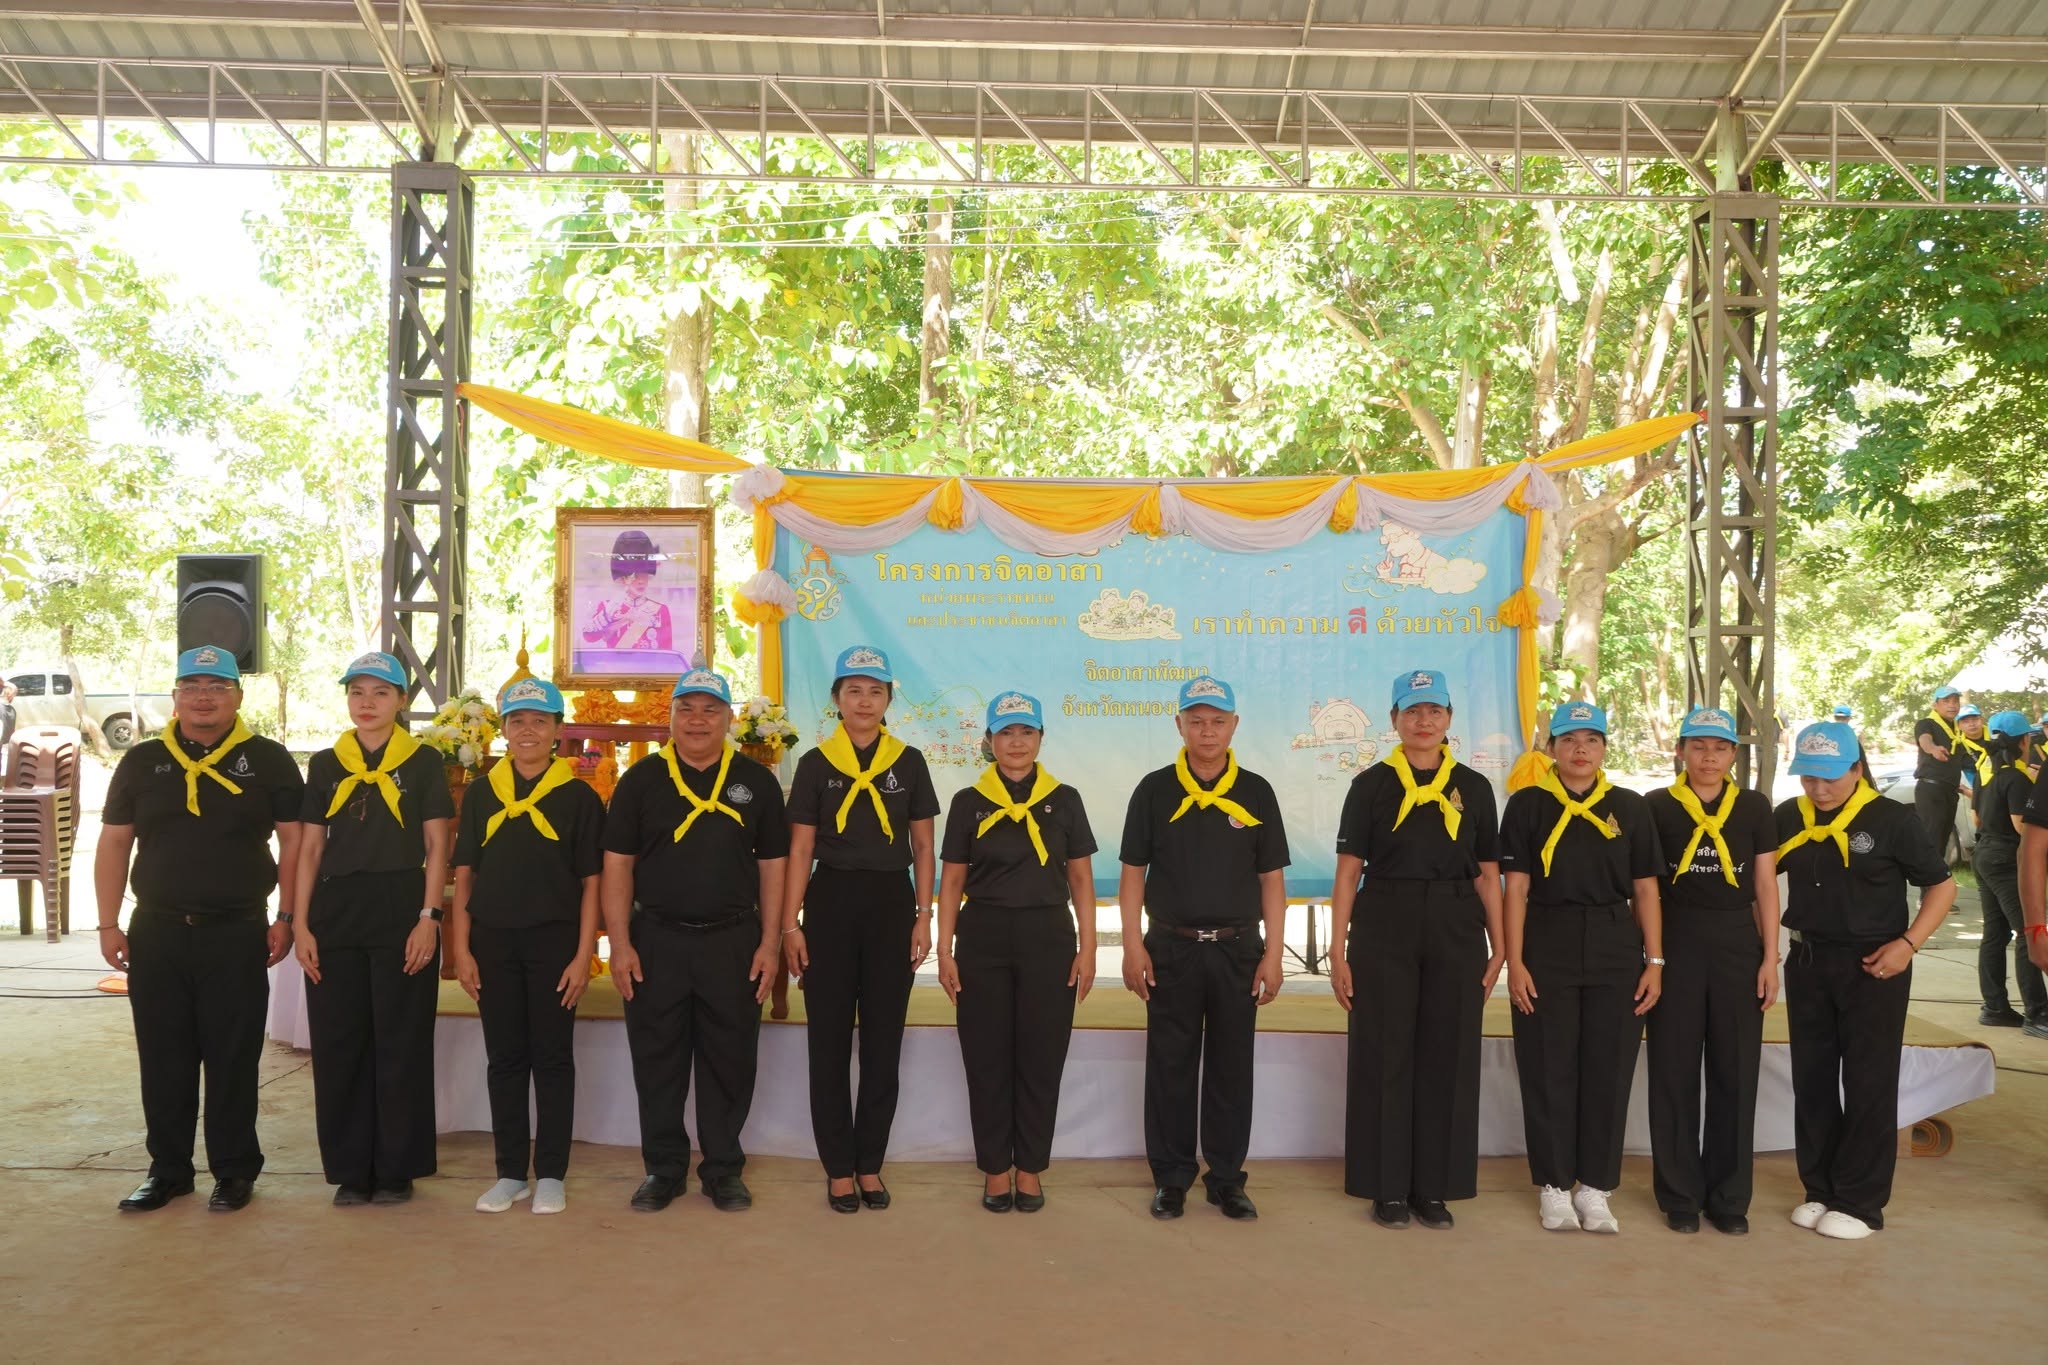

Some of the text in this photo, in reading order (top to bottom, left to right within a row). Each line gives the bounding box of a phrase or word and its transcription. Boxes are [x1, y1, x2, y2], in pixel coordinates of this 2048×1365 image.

[873, 554, 1104, 582] โครงการจิตอาสา
[919, 587, 1056, 605] หน่วยพระราชทาน
[906, 610, 1067, 628] และประชาชนจิตอาสา
[1192, 605, 1502, 635] เราทำความ ดี ด้วยหัวใจ
[1084, 658, 1209, 682] จิตอาสาพัฒนา
